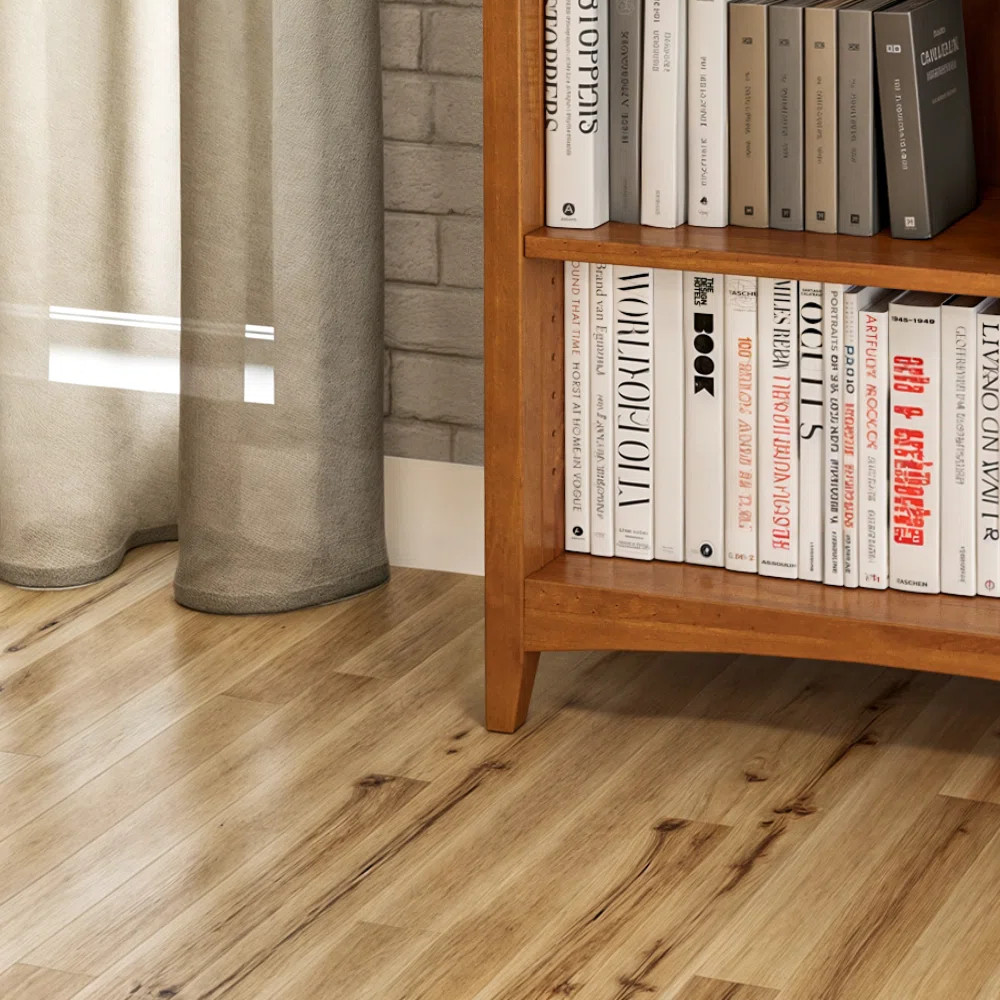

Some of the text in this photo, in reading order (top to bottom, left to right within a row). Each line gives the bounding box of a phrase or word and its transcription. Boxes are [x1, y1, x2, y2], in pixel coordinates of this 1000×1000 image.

[706, 278, 714, 293] THE
[693, 312, 715, 397] BOOK
[572, 473, 581, 512] VOGUE
